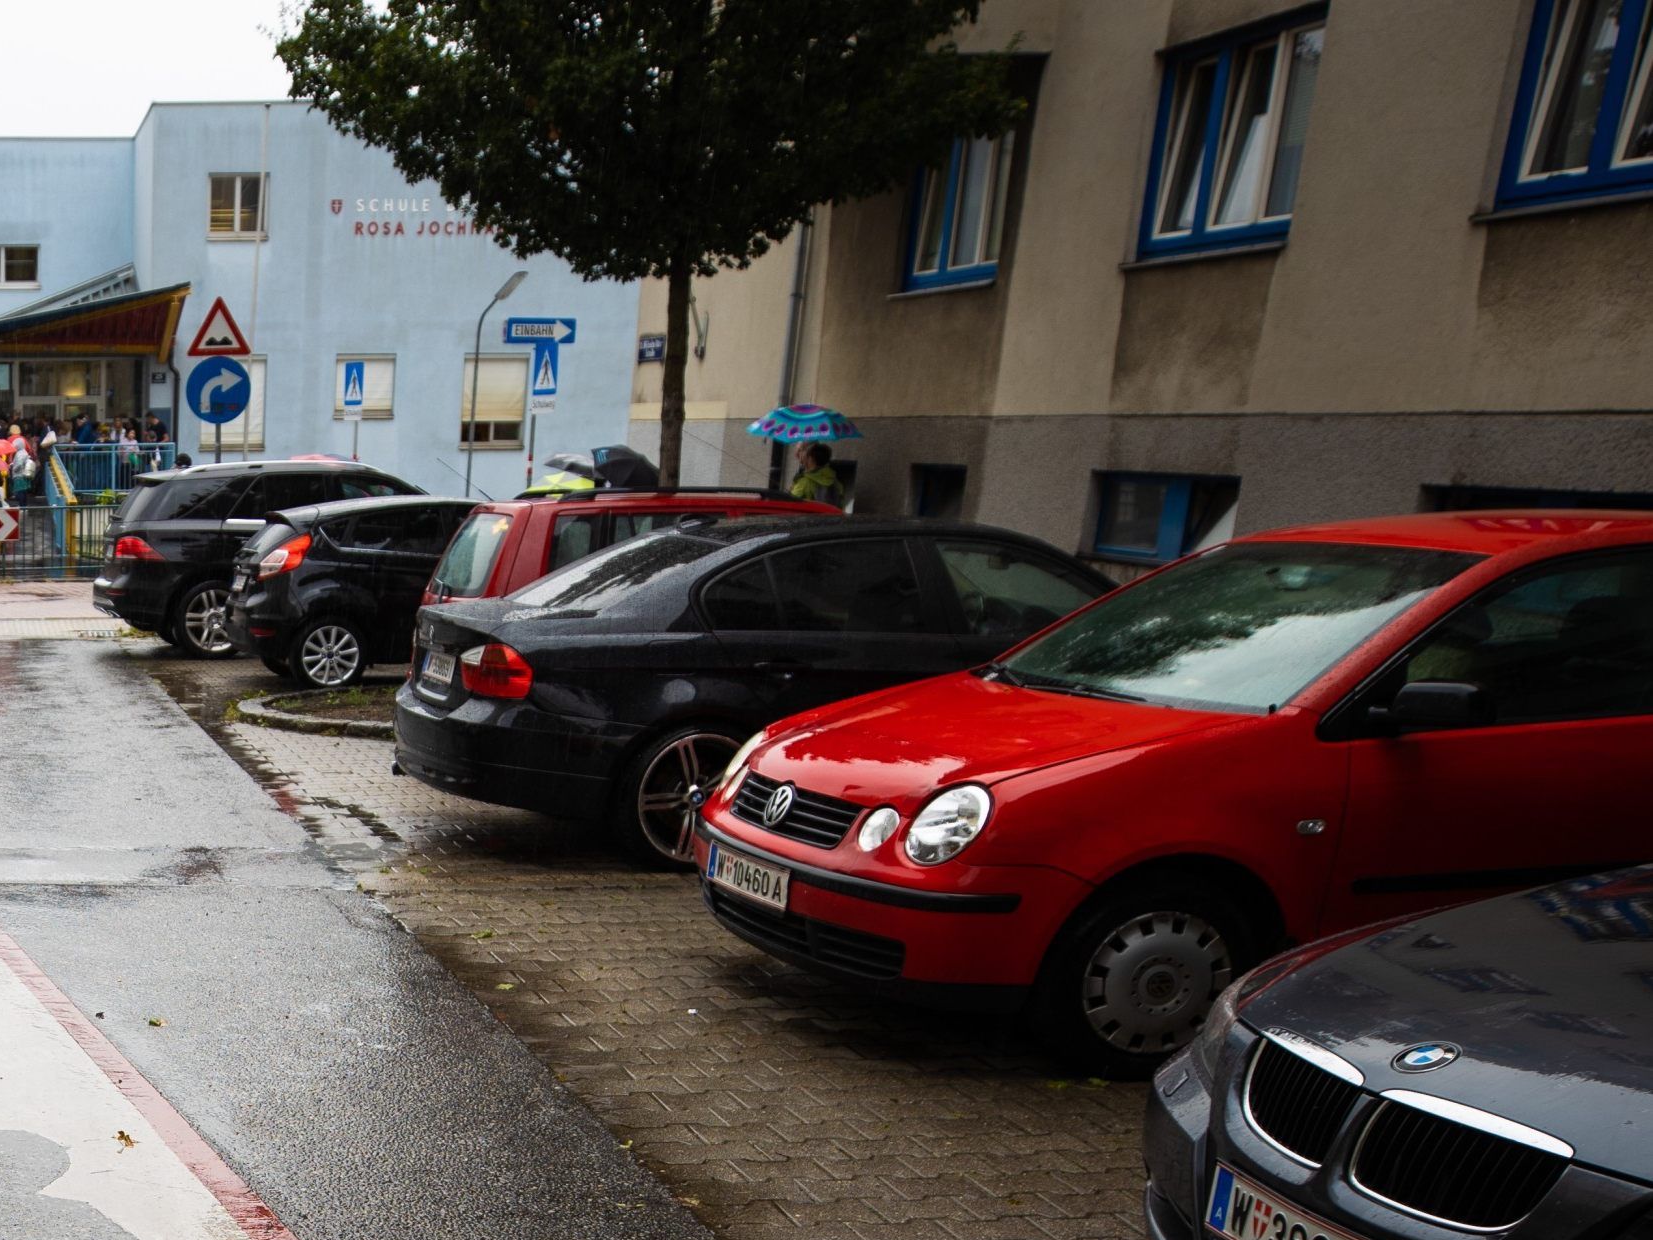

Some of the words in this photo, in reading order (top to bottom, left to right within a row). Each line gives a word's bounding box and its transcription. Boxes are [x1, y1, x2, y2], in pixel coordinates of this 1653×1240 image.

[356, 198, 429, 212] SCHULE
[354, 220, 404, 236] ROSA
[514, 324, 554, 336] EINBAHN
[717, 852, 726, 878] W
[733, 860, 770, 896] 10460
[772, 876, 782, 902] A
[1214, 1207, 1223, 1221] A
[1231, 1185, 1254, 1237] W
